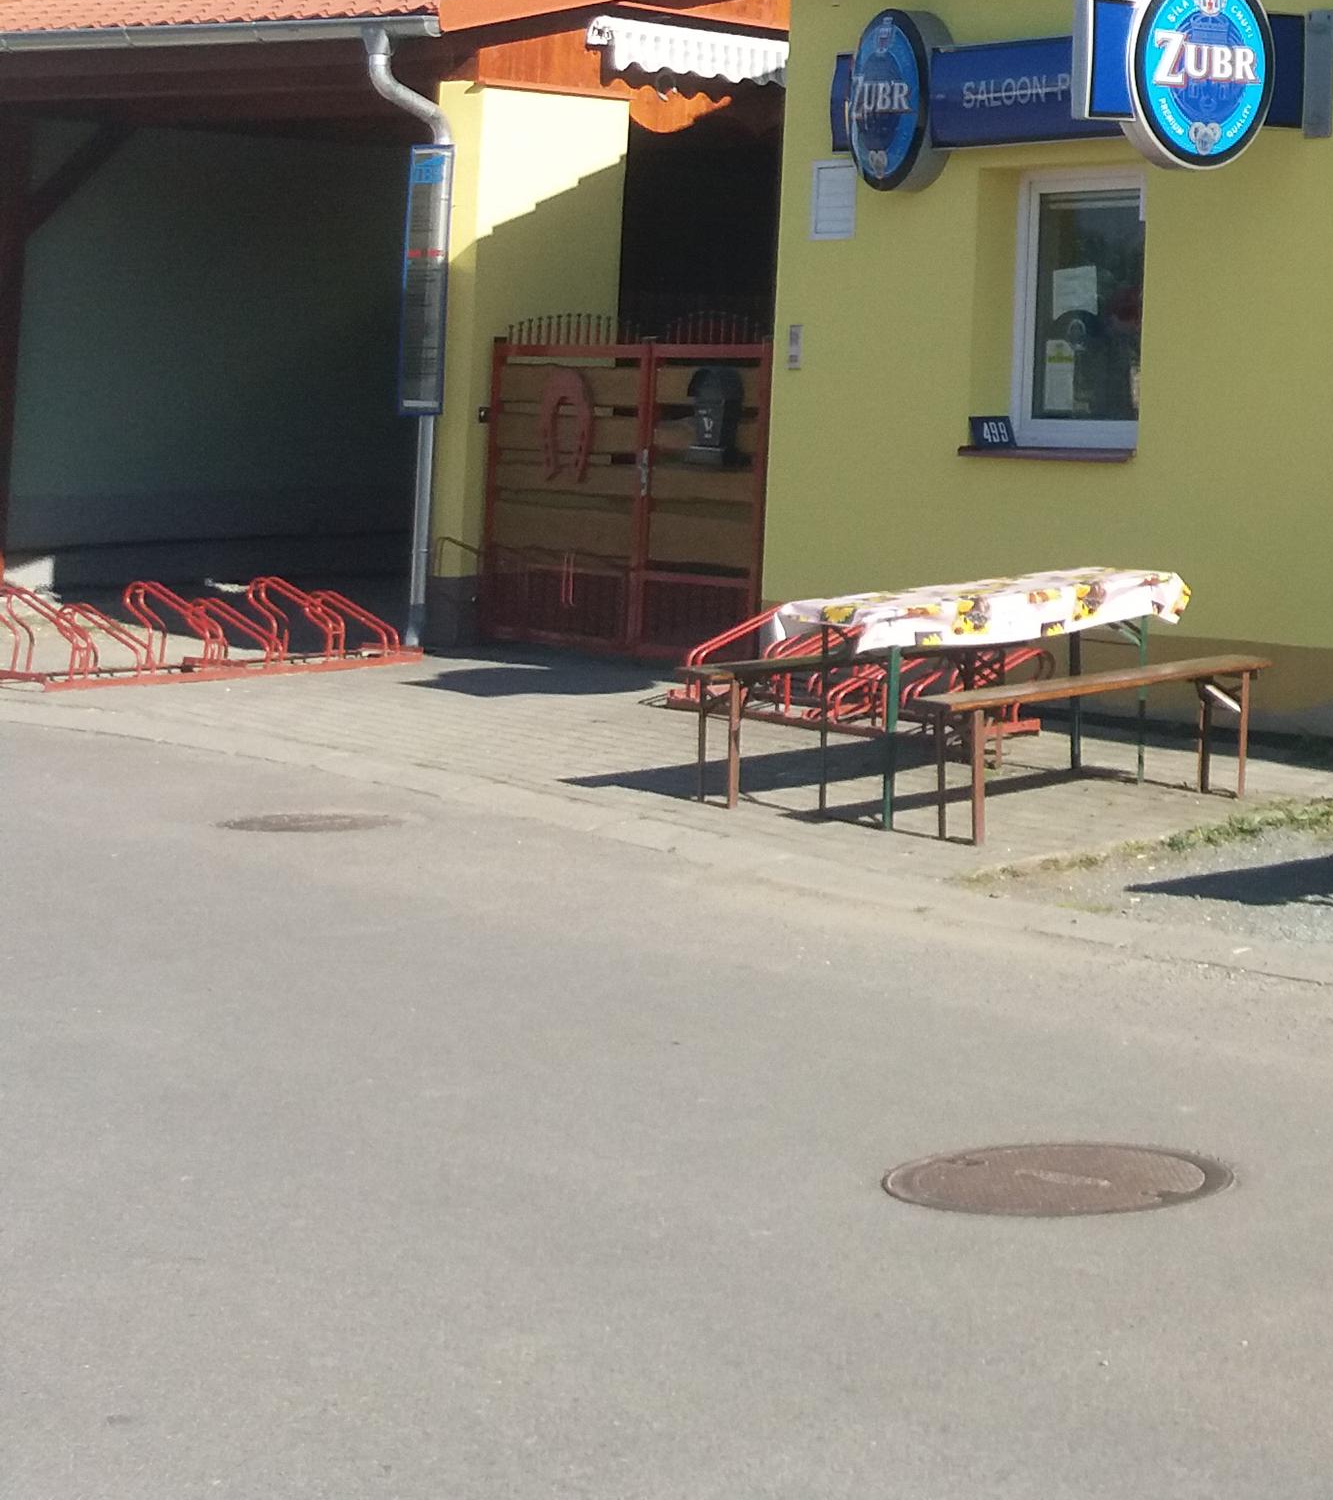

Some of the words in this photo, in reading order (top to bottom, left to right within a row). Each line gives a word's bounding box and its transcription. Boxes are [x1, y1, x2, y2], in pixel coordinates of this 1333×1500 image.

[1154, 28, 1260, 88] ZUBR
[851, 74, 912, 121] ZUBR
[962, 75, 1047, 109] SALOON
[1057, 72, 1071, 103] P
[1159, 97, 1184, 135] PREMIUM
[1226, 104, 1251, 138] QUALITY
[983, 421, 1009, 443] 499
